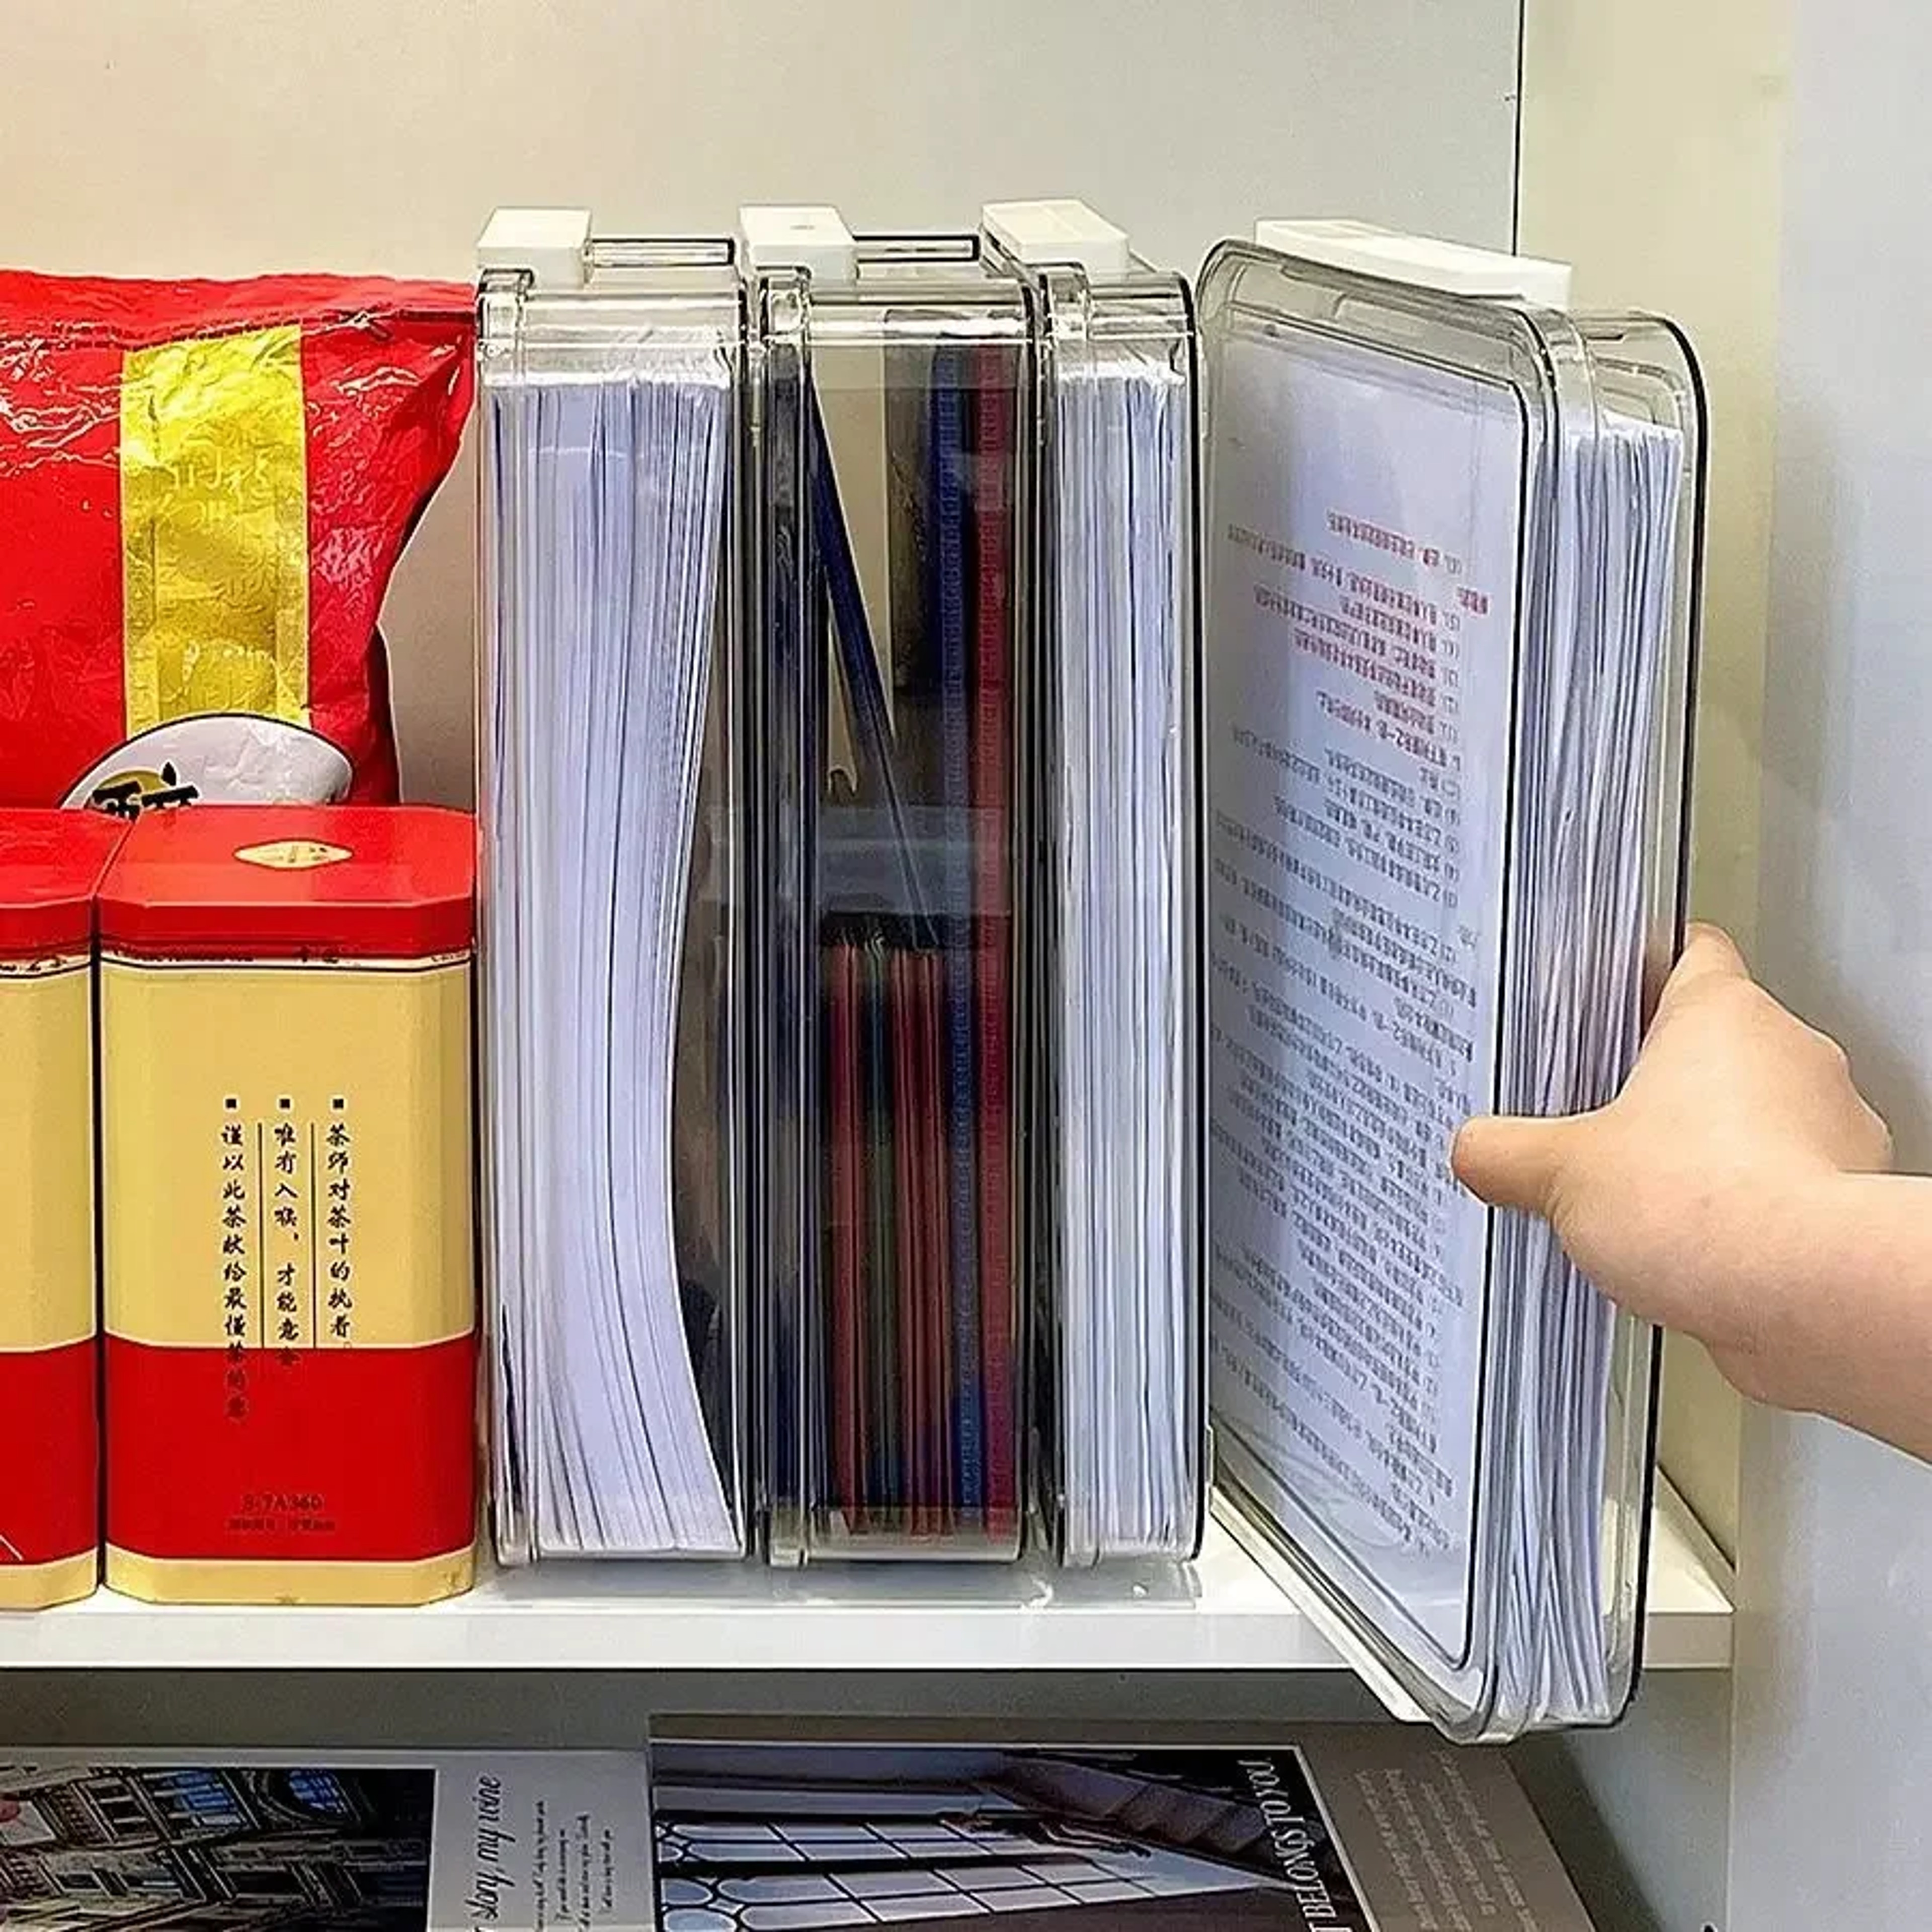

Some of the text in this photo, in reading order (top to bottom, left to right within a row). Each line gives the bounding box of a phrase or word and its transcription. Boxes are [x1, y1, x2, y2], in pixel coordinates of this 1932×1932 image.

[1259, 1800, 1306, 1826] TO
[476, 1828, 515, 1863] my
[1271, 1828, 1337, 1918] BELONGS
